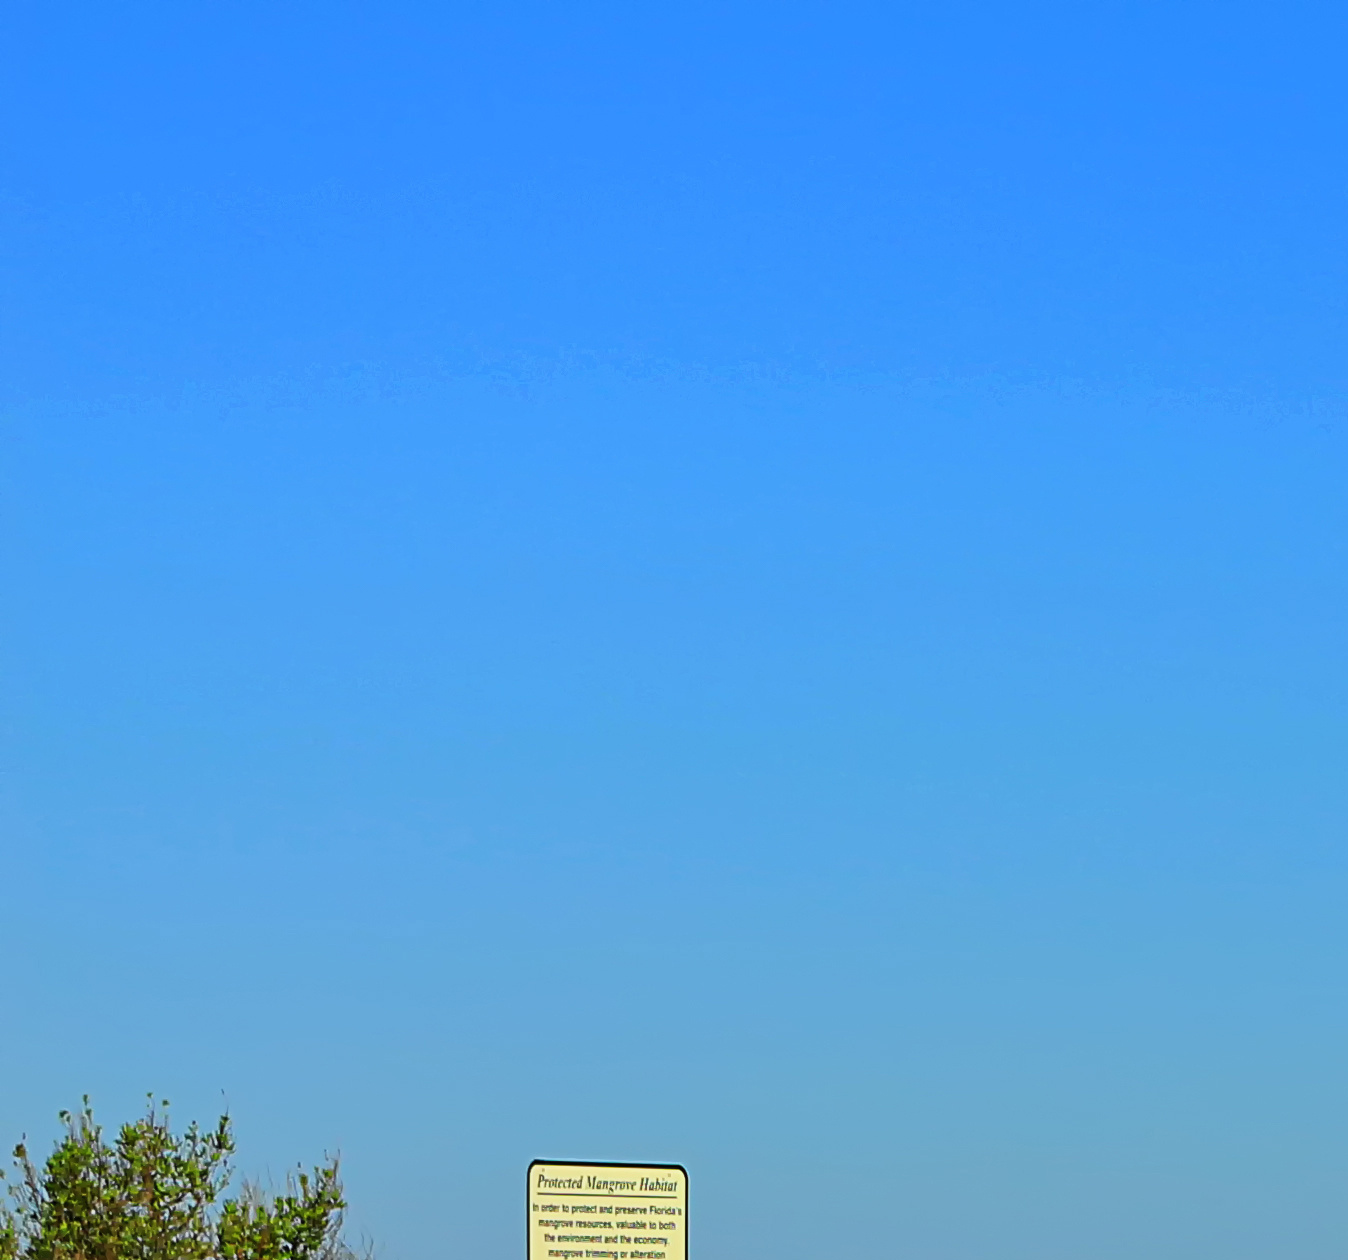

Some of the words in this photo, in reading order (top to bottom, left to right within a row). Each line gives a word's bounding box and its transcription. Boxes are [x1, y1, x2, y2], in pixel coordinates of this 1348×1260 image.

[538, 1174, 583, 1189] Protected
[585, 1176, 636, 1195] Mangrove
[640, 1178, 677, 1191] Habitat
[541, 1204, 560, 1212] order
[562, 1204, 569, 1212] to
[572, 1205, 597, 1214] protect
[599, 1206, 613, 1214] and
[615, 1207, 647, 1215] preserve
[650, 1206, 681, 1215] Florida's
[539, 1220, 573, 1230] mangrove
[616, 1221, 647, 1229] valuable
[659, 1222, 675, 1230] both
[544, 1234, 555, 1242] the
[558, 1235, 602, 1243] environment
[620, 1236, 631, 1244] the
[548, 1250, 583, 1260] mangrove
[586, 1250, 618, 1260] trimming
[630, 1250, 665, 1259] alteration
